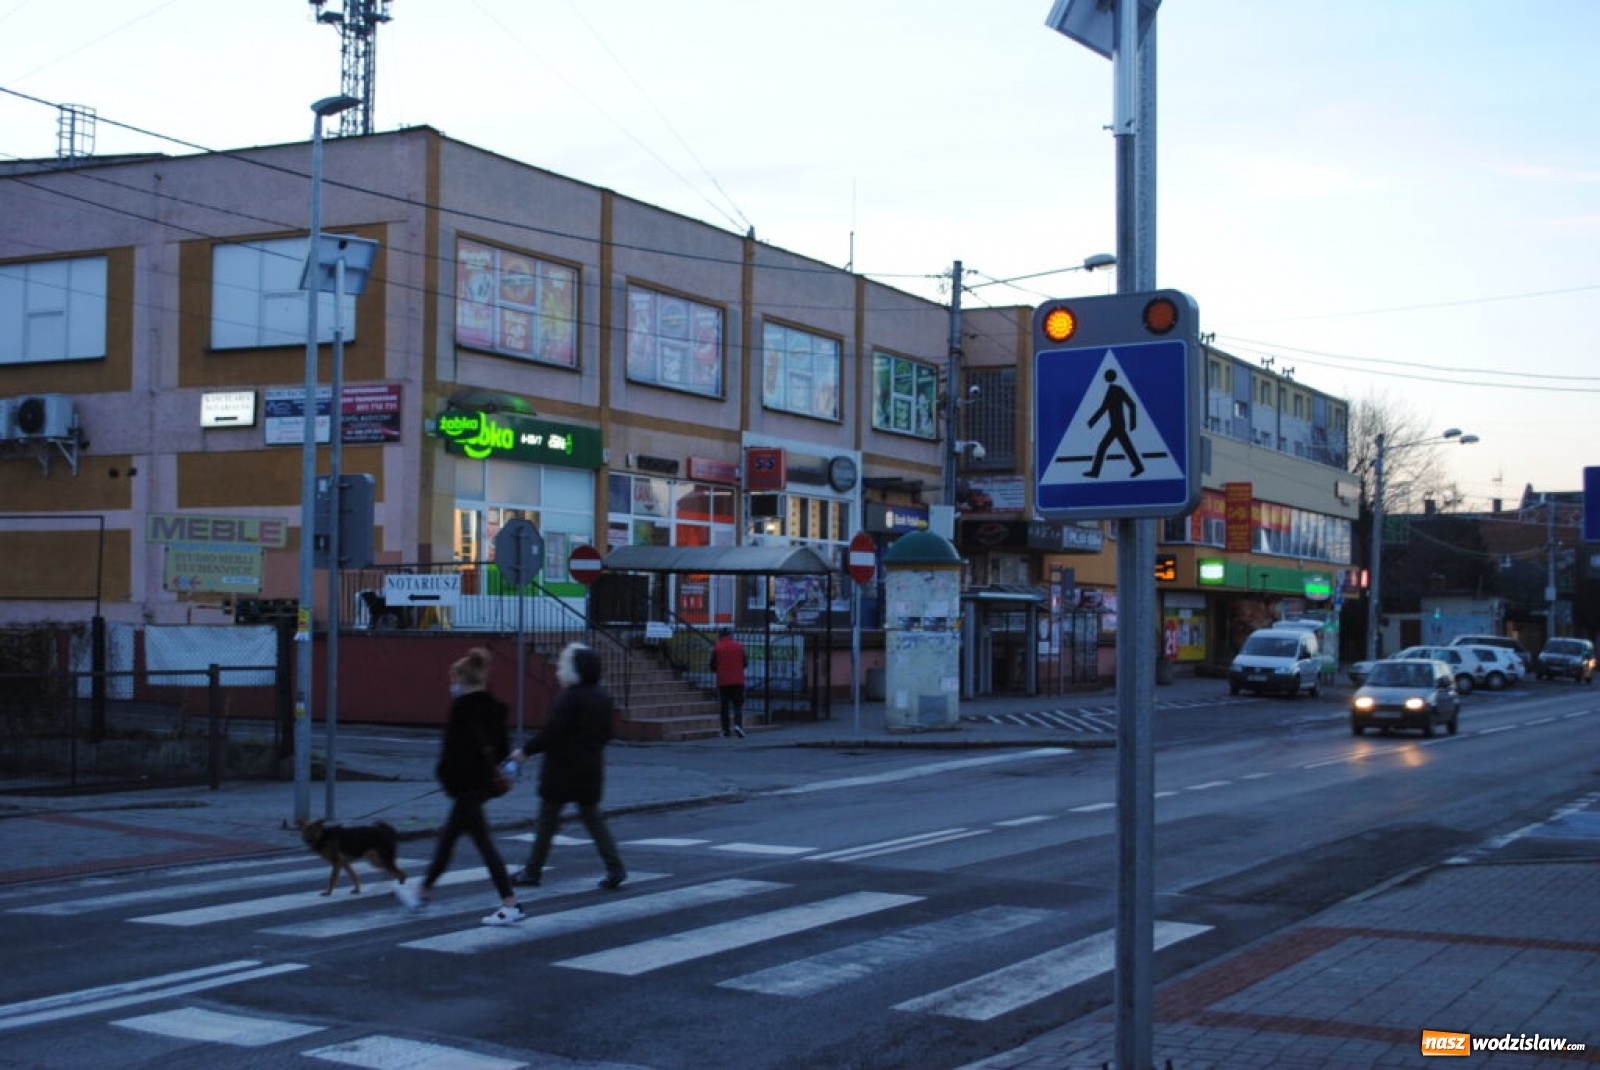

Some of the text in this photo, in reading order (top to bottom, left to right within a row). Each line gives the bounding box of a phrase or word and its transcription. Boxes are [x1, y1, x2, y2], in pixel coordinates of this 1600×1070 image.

[440, 416, 479, 430] żabka
[152, 516, 282, 543] MEBLE
[388, 577, 459, 590] NOTARIUSZ
